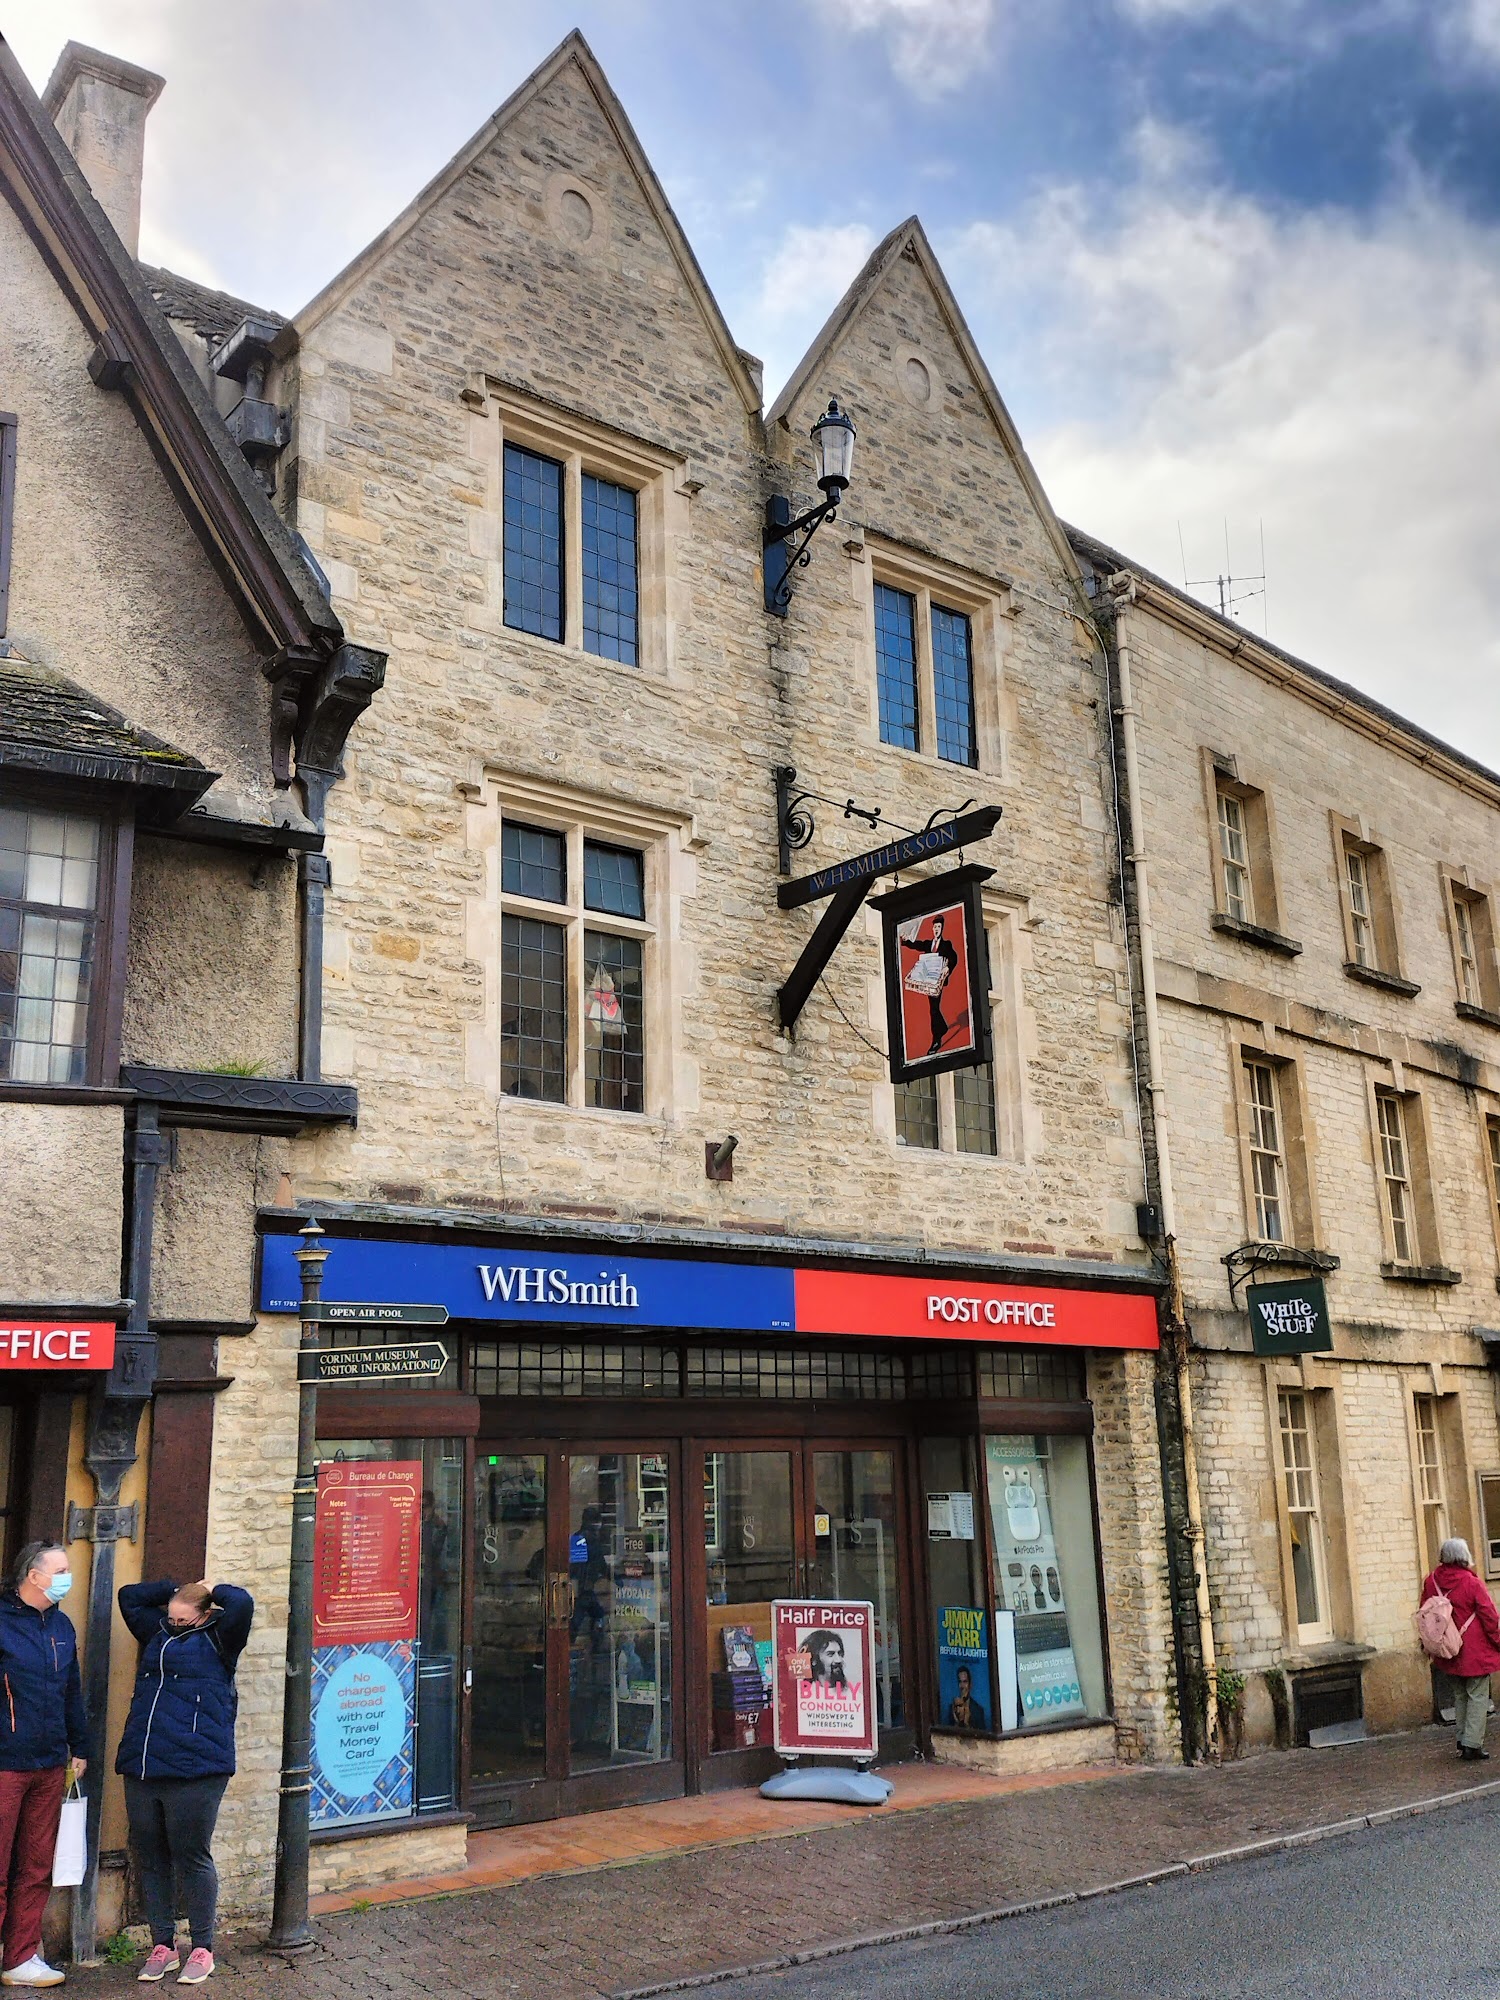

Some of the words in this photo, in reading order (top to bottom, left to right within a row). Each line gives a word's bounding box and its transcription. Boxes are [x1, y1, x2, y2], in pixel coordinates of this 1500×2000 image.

[902, 842, 915, 860] &
[915, 824, 956, 855] SON
[1149, 1207, 1155, 1216] 3
[477, 1264, 639, 1307] WHSmith
[329, 1308, 356, 1317] OPEN
[357, 1308, 376, 1317] AIR
[378, 1309, 404, 1318] POOL
[926, 1296, 982, 1322] POST
[983, 1298, 1056, 1327] OFFICE
[319, 1352, 372, 1365] CORINIUM
[374, 1350, 420, 1362] MUSEUM
[320, 1363, 359, 1376] VISITOR
[361, 1360, 431, 1374] INFORMATION
[349, 1471, 377, 1481] Bureau
[377, 1471, 386, 1480] de
[387, 1470, 414, 1481] Change
[623, 1537, 644, 1550] Free
[780, 1608, 816, 1624] Half
[821, 1609, 866, 1626] Price
[942, 1610, 984, 1630] JIMMY
[947, 1629, 981, 1648] CARR
[791, 1658, 807, 1666] Only
[353, 1673, 371, 1683] No
[337, 1683, 387, 1699] charges
[800, 1680, 862, 1701] BILLY
[339, 1696, 383, 1710] abroad
[800, 1701, 862, 1713] CONNOLLY
[336, 1711, 363, 1723] with
[365, 1709, 386, 1720] our
[748, 1712, 759, 1724] £7
[806, 1712, 848, 1720] WINDSWEPT
[343, 1721, 380, 1735] Travel
[808, 1720, 854, 1728] INTERESTING
[339, 1735, 382, 1748] Money
[345, 1747, 375, 1760] Card
